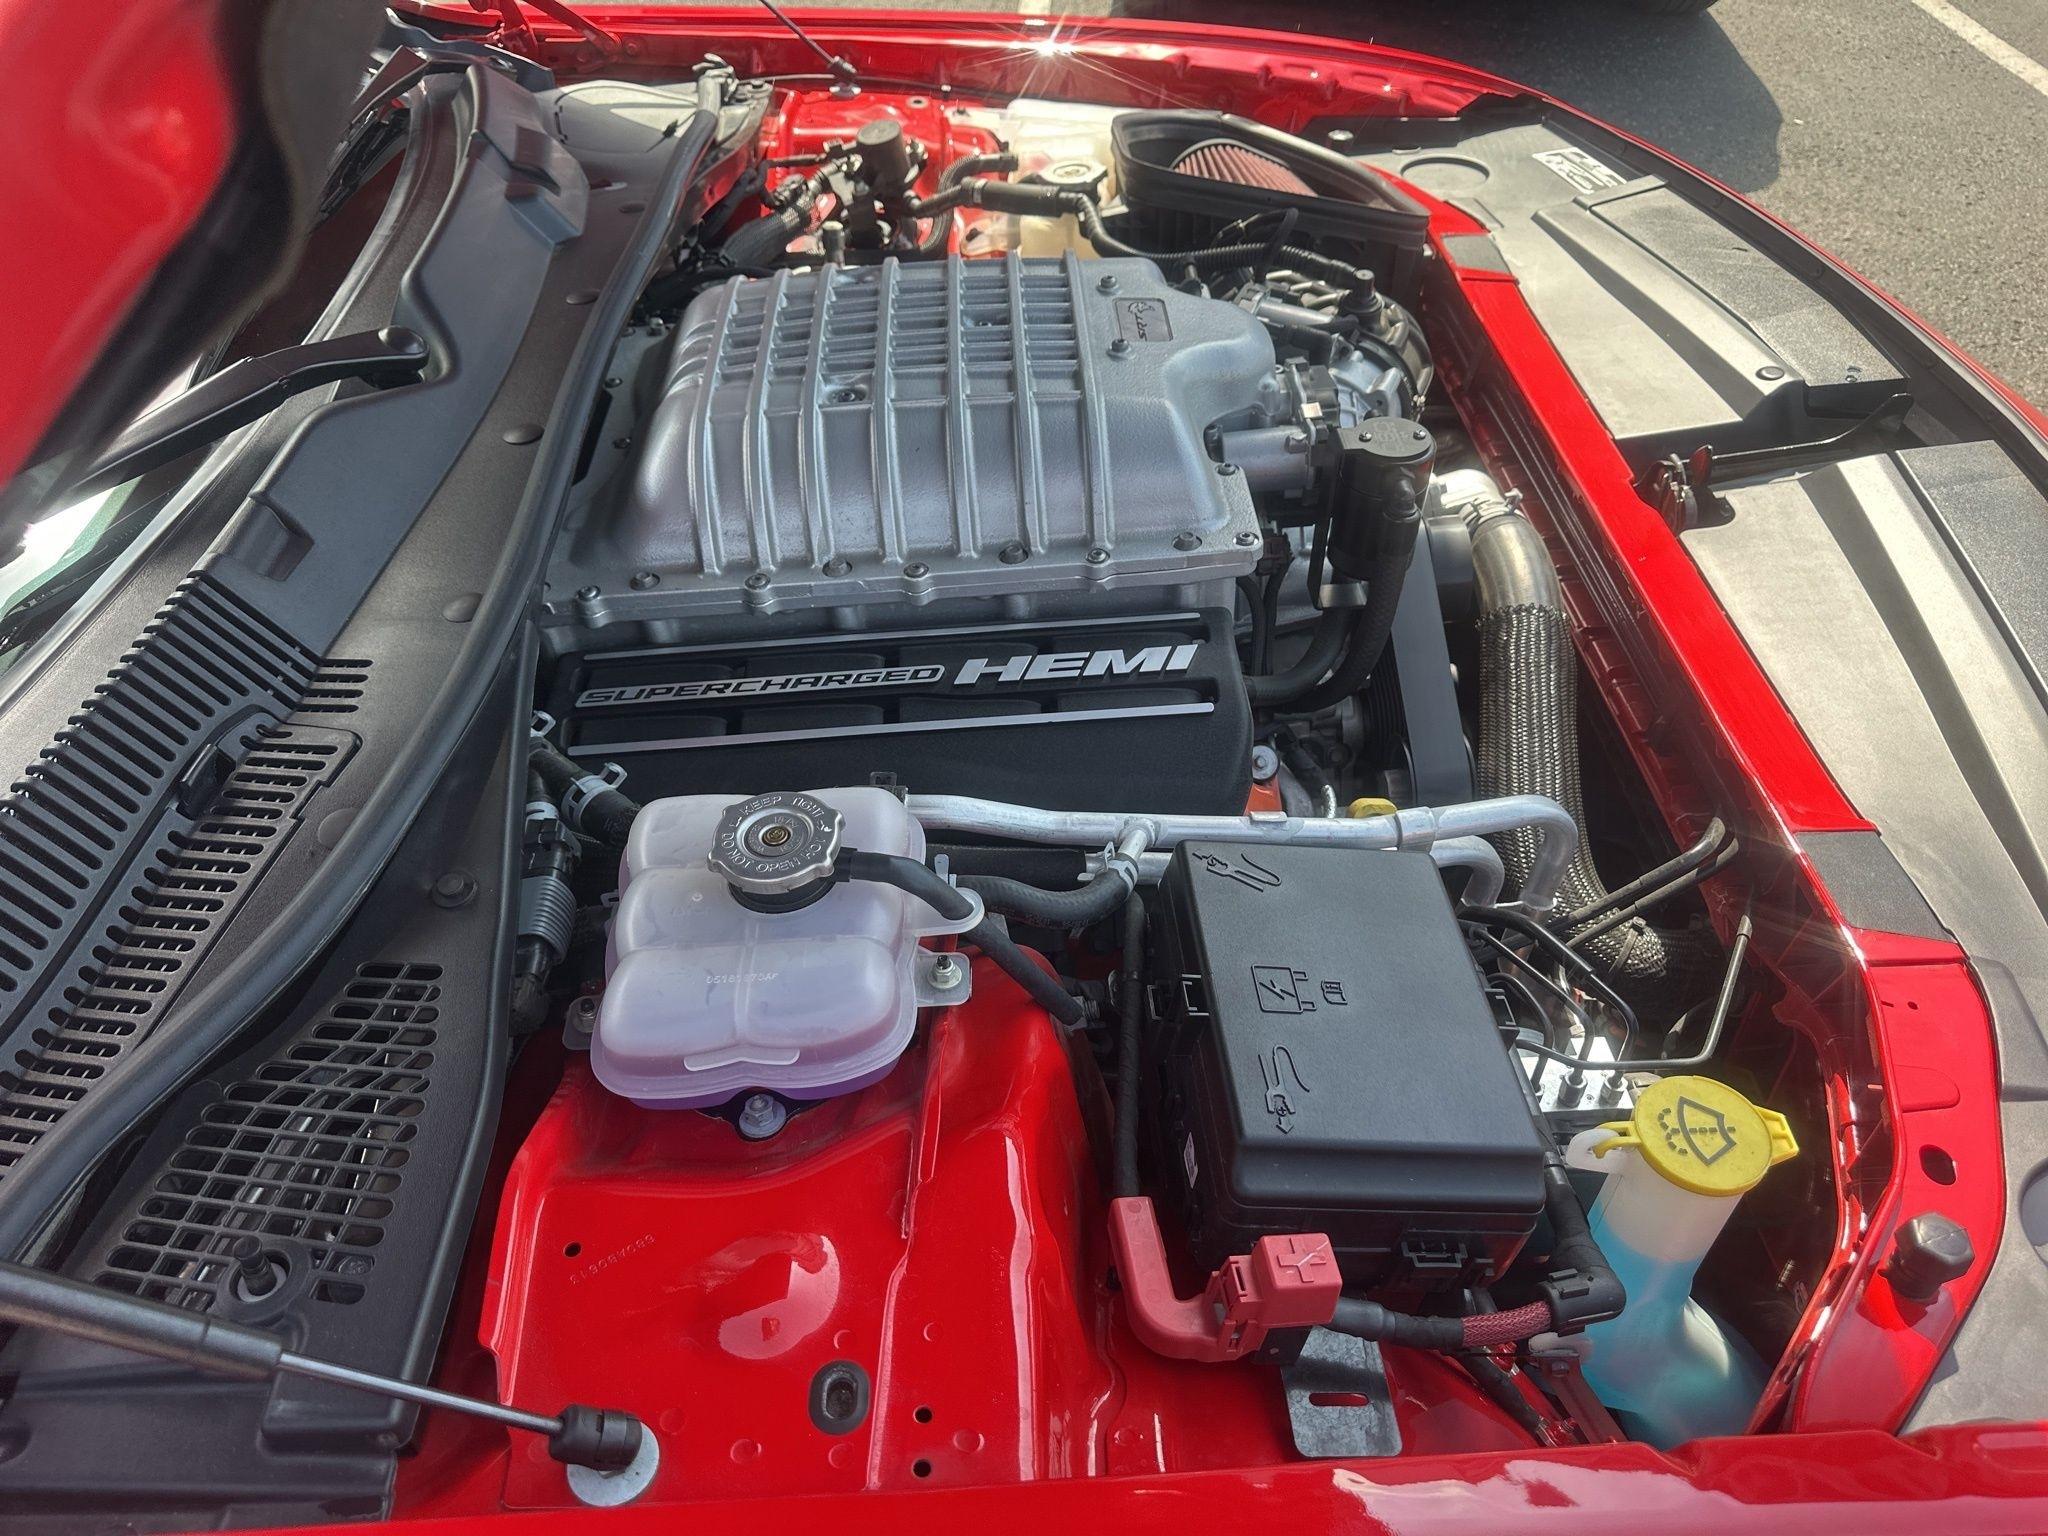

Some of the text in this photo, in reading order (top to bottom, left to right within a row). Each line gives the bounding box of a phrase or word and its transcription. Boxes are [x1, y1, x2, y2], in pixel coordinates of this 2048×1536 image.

[584, 644, 1198, 705] SUPERCHARGED HEMI
[740, 796, 782, 816] KEEP
[727, 849, 754, 868] NOT
[756, 856, 801, 873] OPEN
